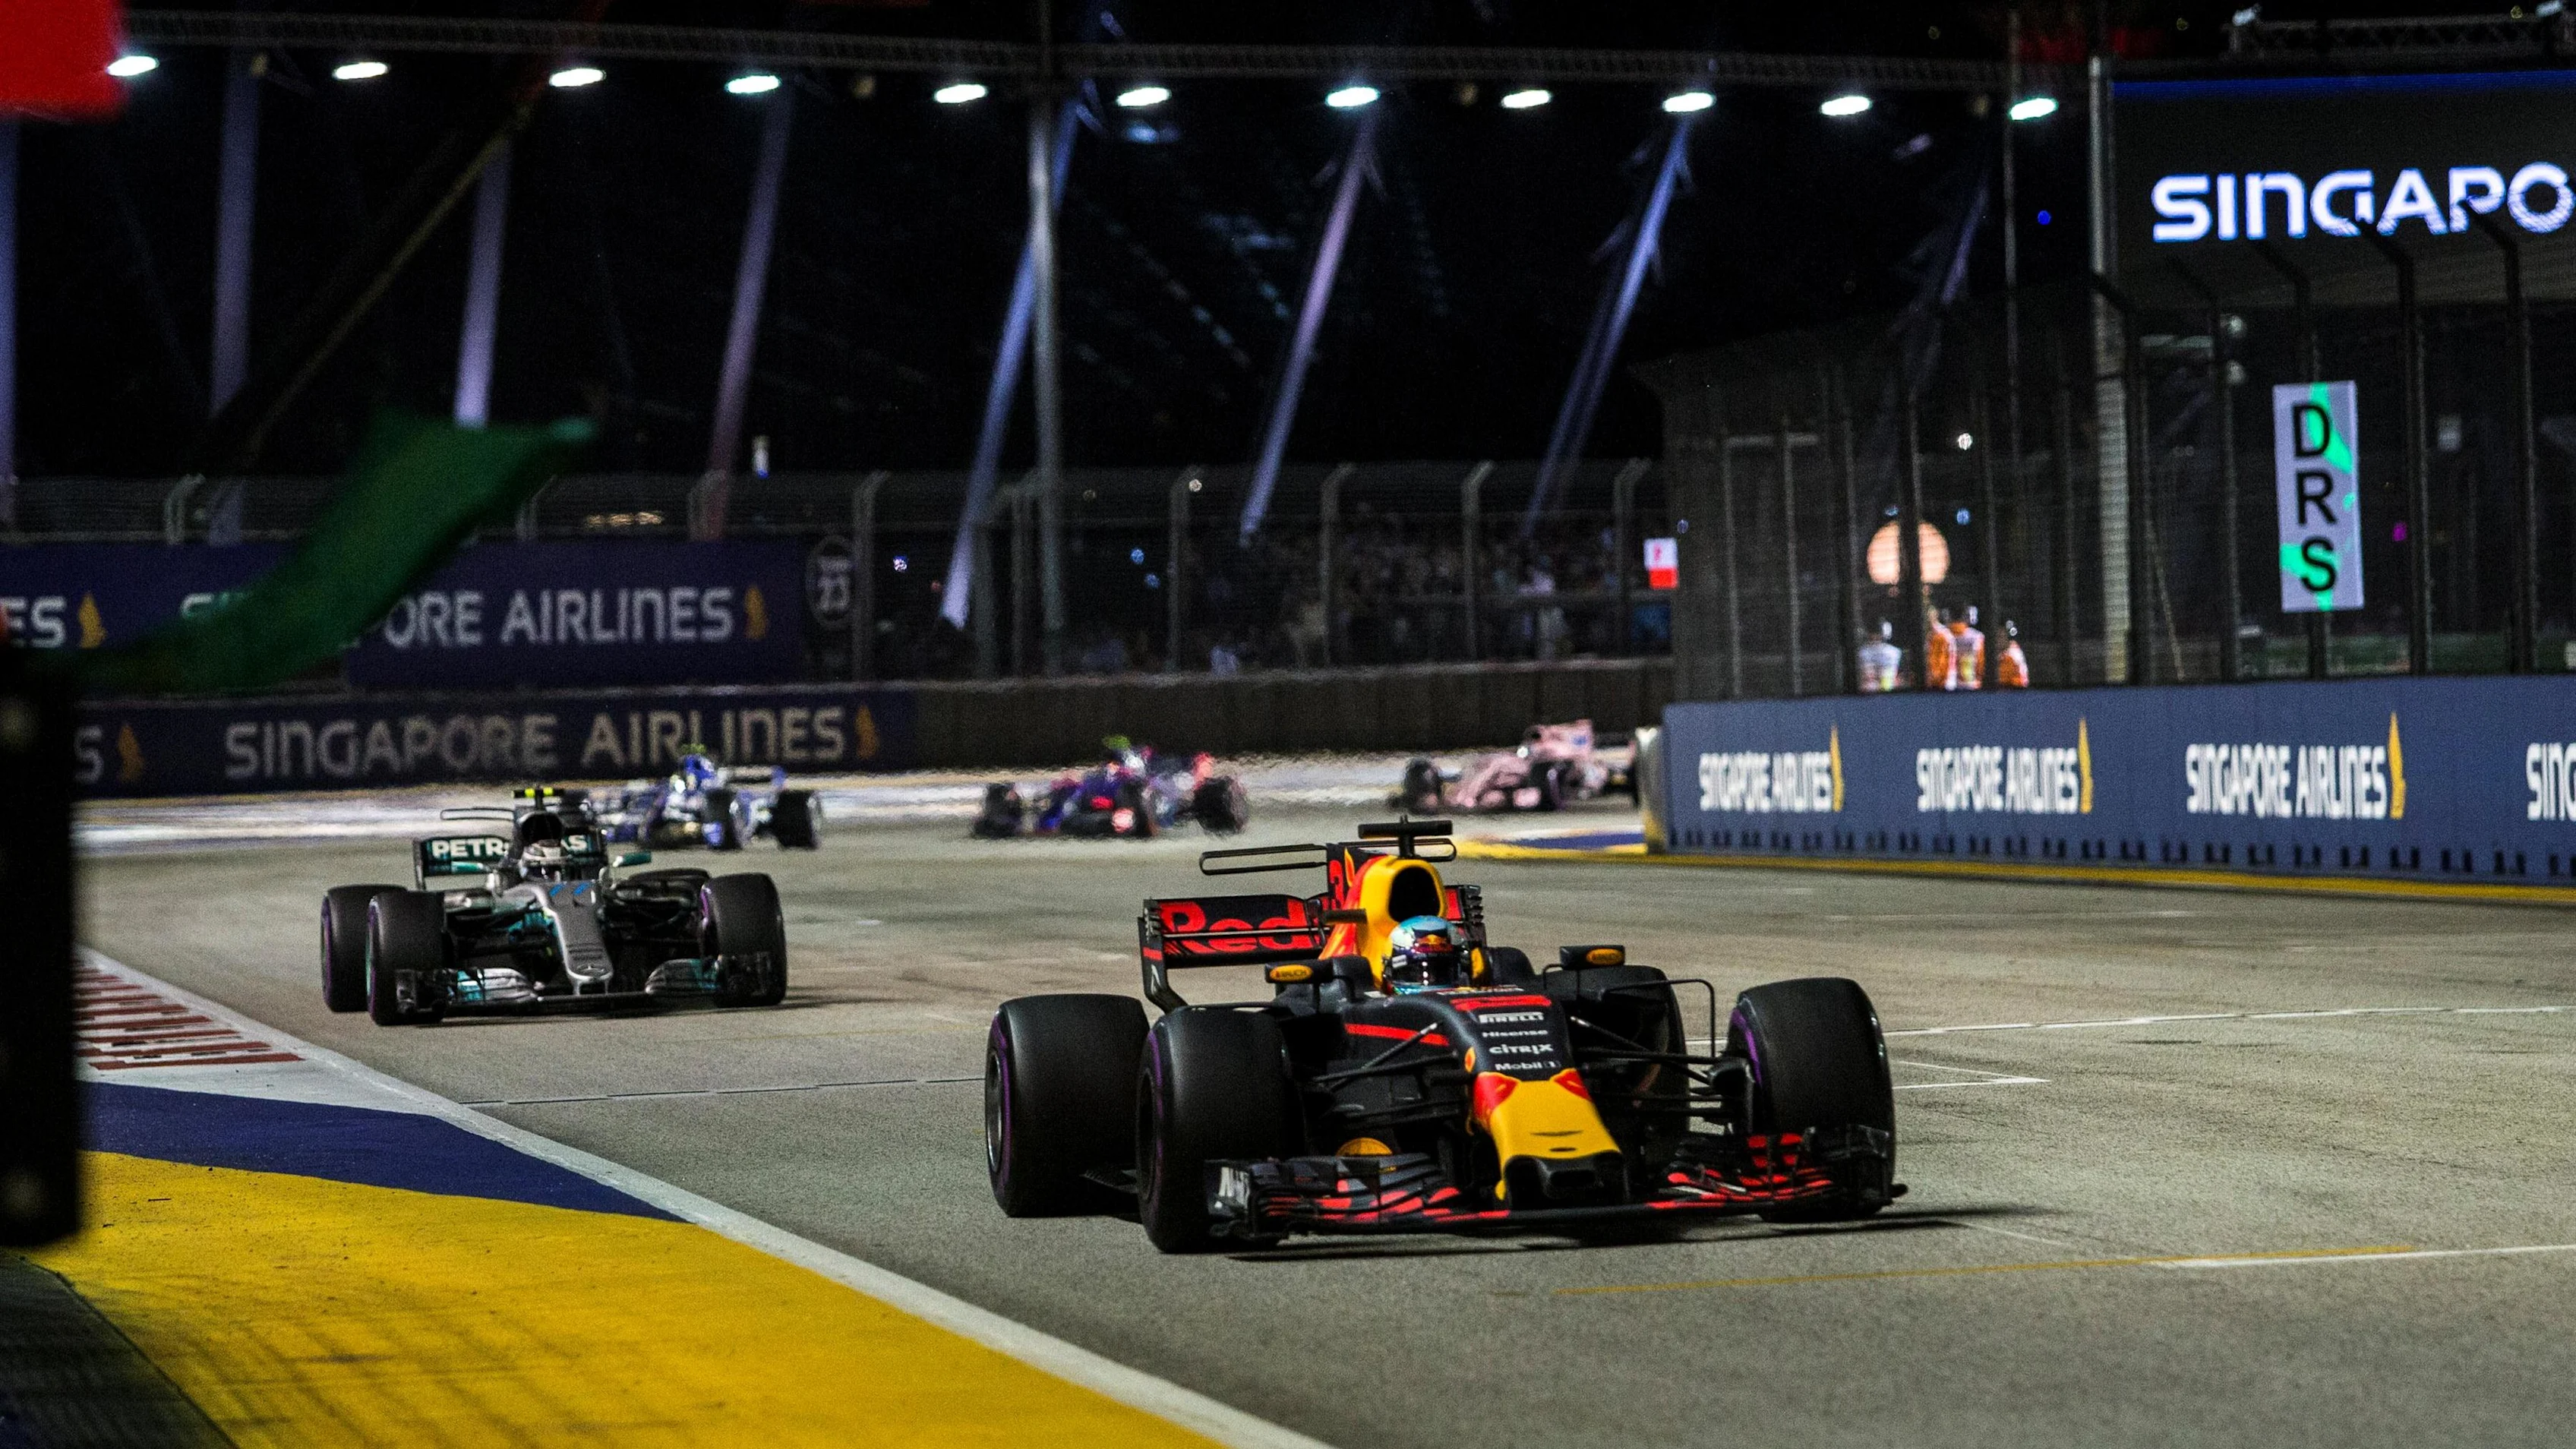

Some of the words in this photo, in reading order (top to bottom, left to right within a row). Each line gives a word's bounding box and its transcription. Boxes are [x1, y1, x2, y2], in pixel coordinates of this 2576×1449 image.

[2151, 161, 2576, 242] SINGAPO
[2292, 403, 2338, 592] DRS
[500, 586, 734, 645] AIRLINES
[225, 715, 557, 778] SINGAPORE
[581, 706, 844, 769] AIRLINES
[1699, 750, 1770, 813] SINGAPORE
[1772, 751, 1832, 813] AIRLINES
[1916, 744, 2003, 813] SINGAPORE
[2004, 747, 2079, 813] AIRLINES
[2186, 742, 2292, 819] SINGAPORE
[2297, 744, 2388, 819] AIRLINES
[1158, 898, 1314, 955] Red
[1478, 1012, 1544, 1024] PIRELLI
[1494, 1062, 1542, 1071] Mobil
